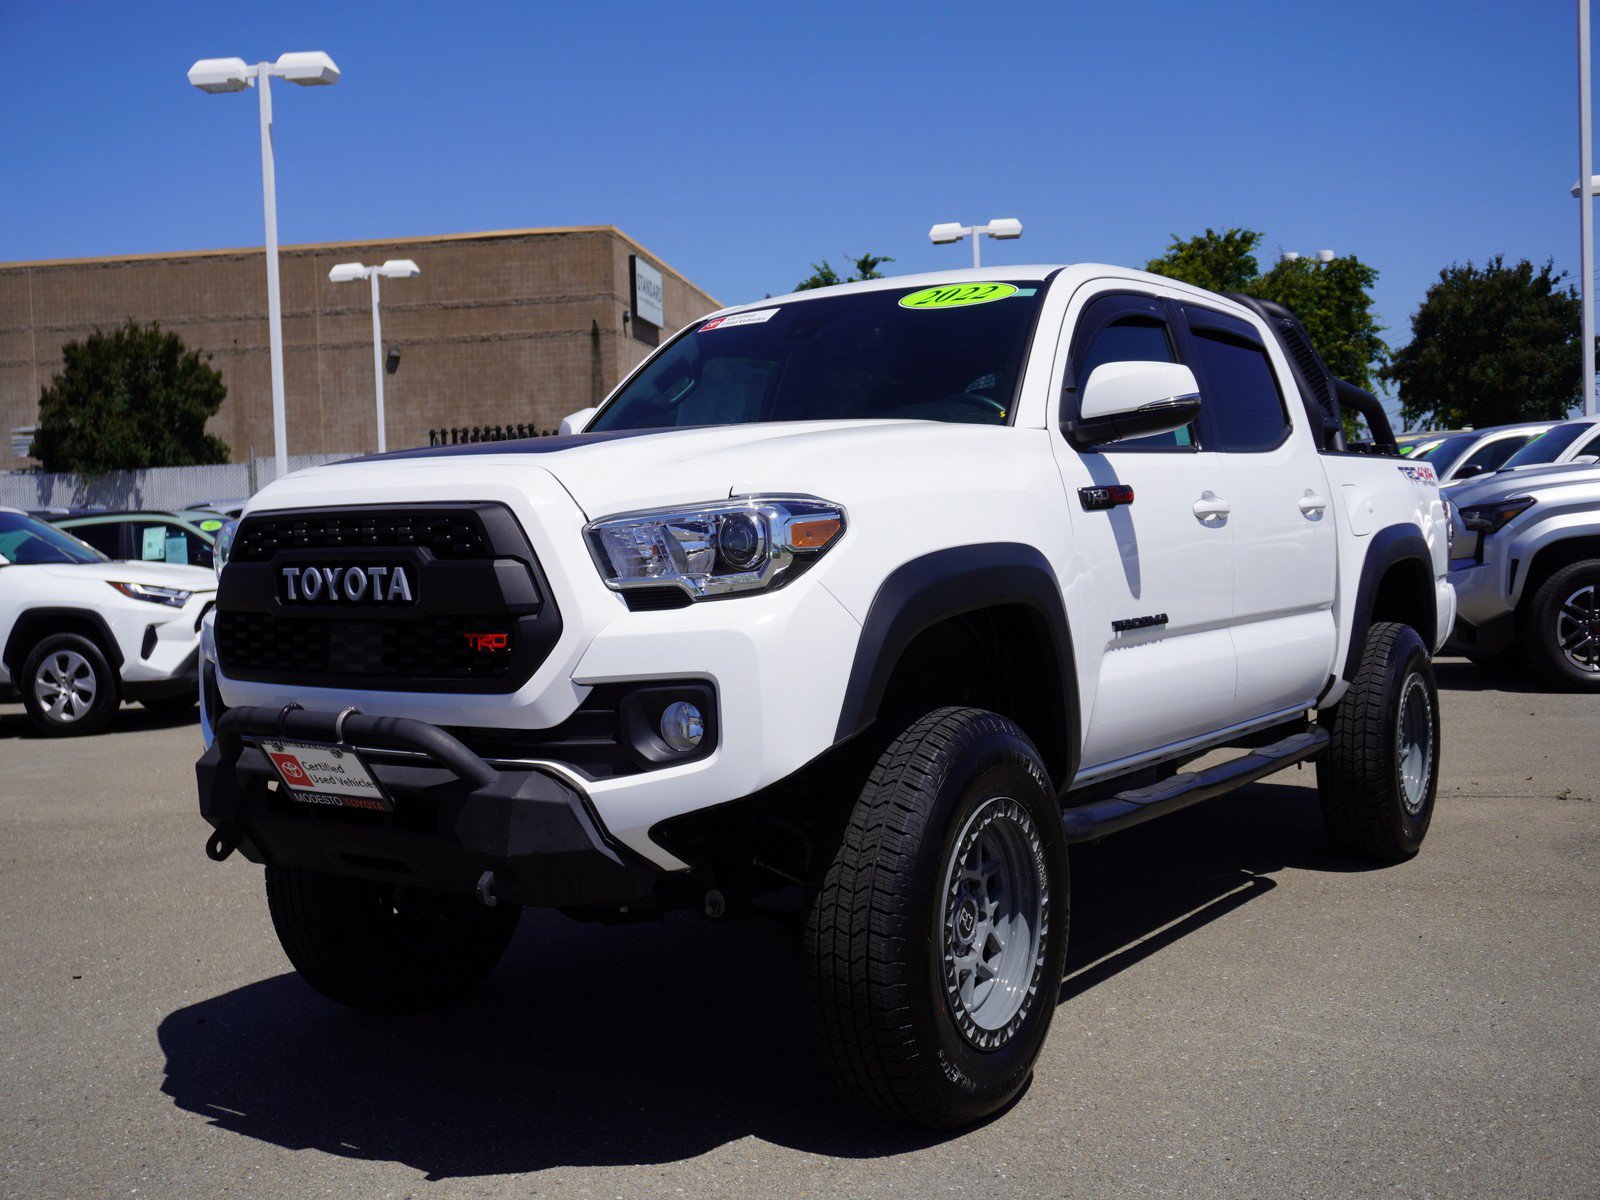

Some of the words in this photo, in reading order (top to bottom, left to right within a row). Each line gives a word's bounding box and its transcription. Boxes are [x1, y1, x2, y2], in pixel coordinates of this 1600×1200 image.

[913, 286, 999, 305] 2022
[282, 566, 413, 601] TOYOTA
[464, 633, 507, 651] TRD
[301, 761, 345, 774] Certified
[309, 775, 336, 785] Used
[294, 792, 343, 806] MODESTO
[346, 799, 386, 811] TOYOTA
